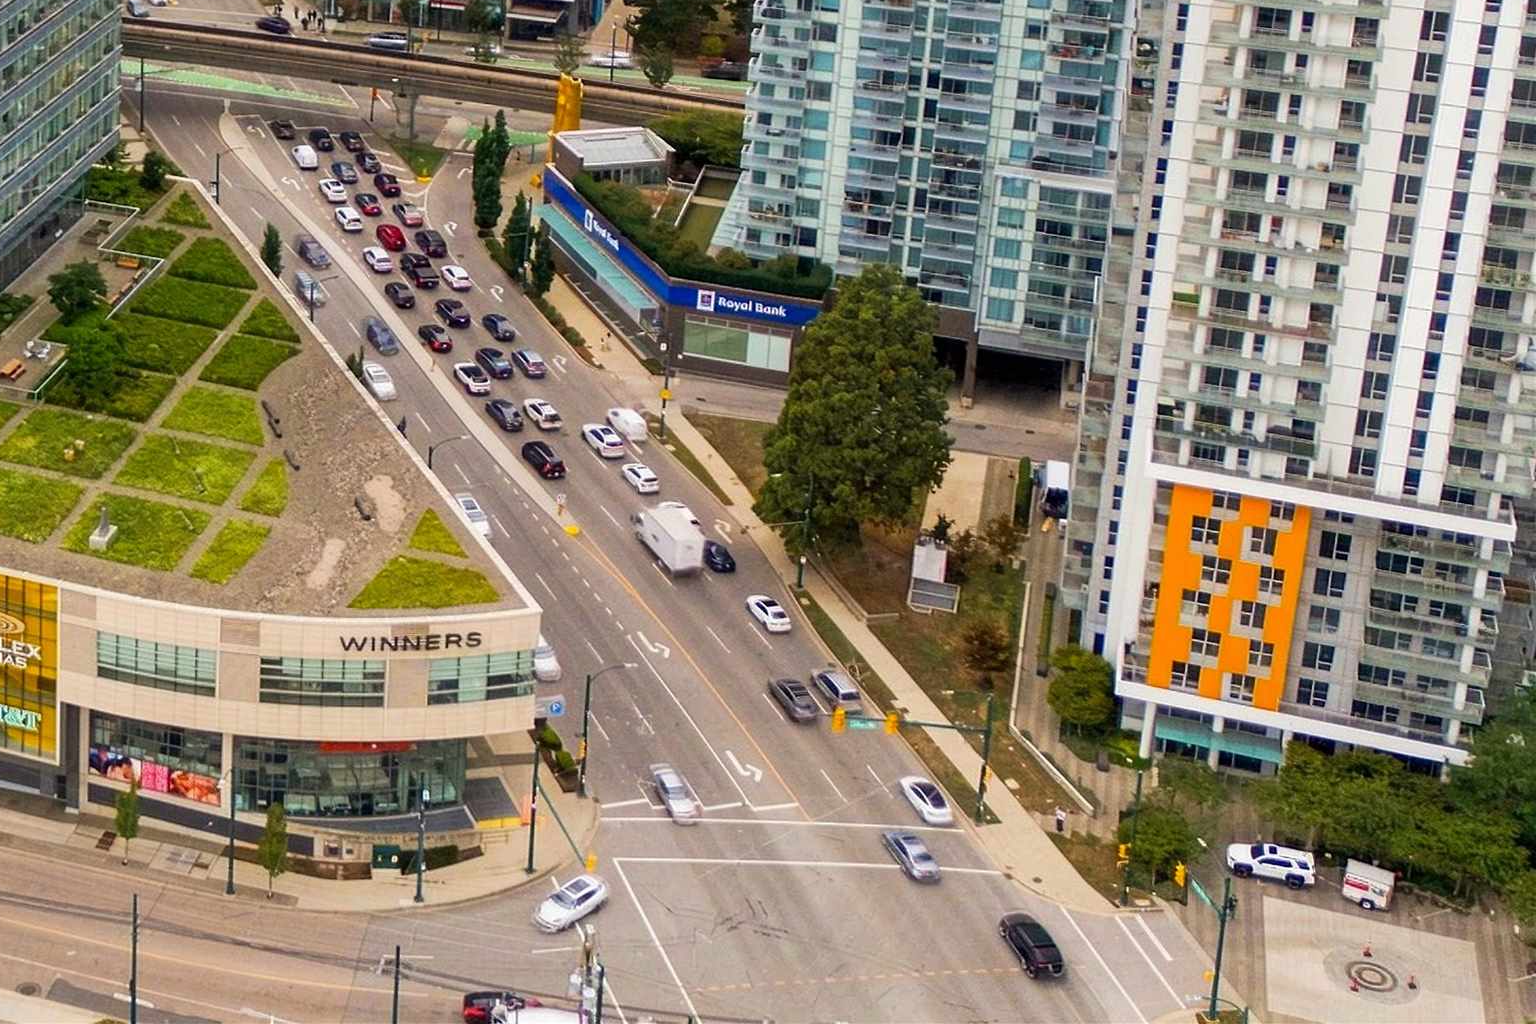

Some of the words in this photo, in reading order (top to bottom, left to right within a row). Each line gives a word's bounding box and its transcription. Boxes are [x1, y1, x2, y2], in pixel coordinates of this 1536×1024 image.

[718, 296, 752, 311] Royal
[755, 303, 787, 317] Bank
[339, 632, 482, 652] WINNERS
